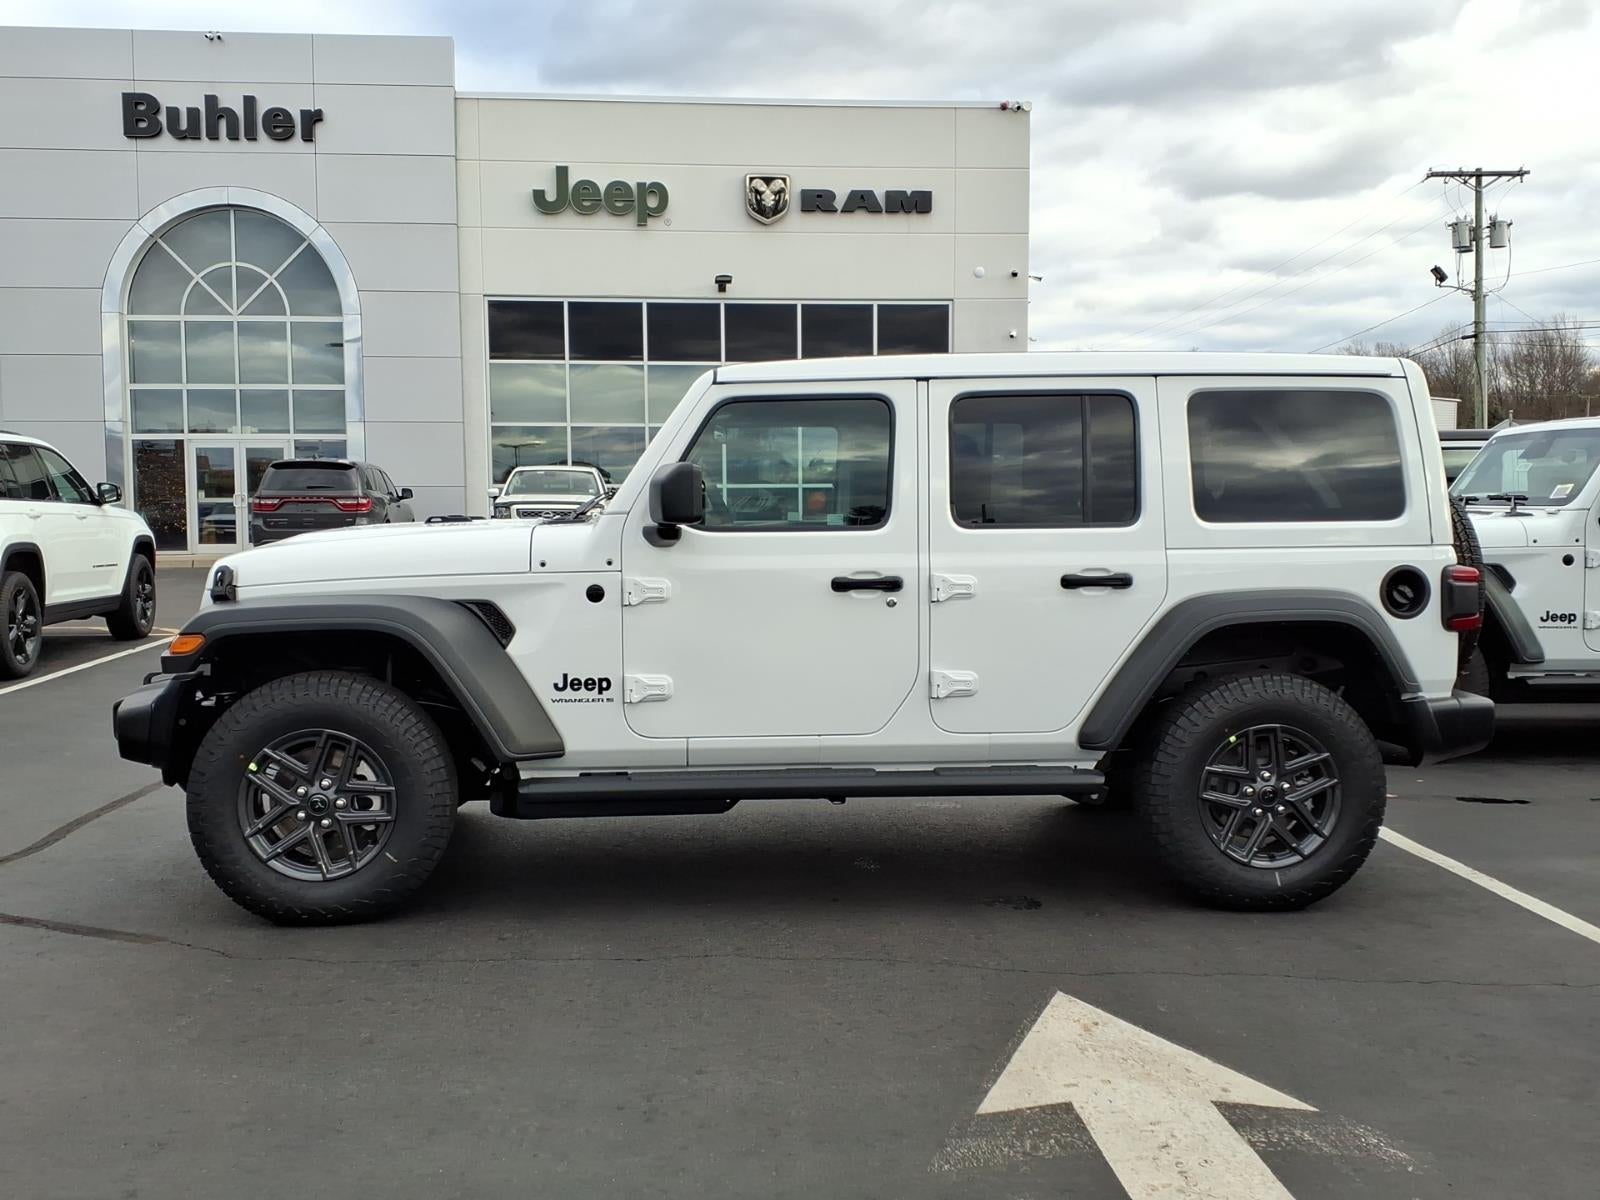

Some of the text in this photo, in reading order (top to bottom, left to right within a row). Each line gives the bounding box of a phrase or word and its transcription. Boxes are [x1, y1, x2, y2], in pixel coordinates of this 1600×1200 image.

[122, 92, 323, 142] Buhler
[532, 165, 670, 227] Jeep
[800, 188, 933, 214] RAM
[1540, 610, 1577, 624] Jeep
[553, 673, 612, 695] Jeep
